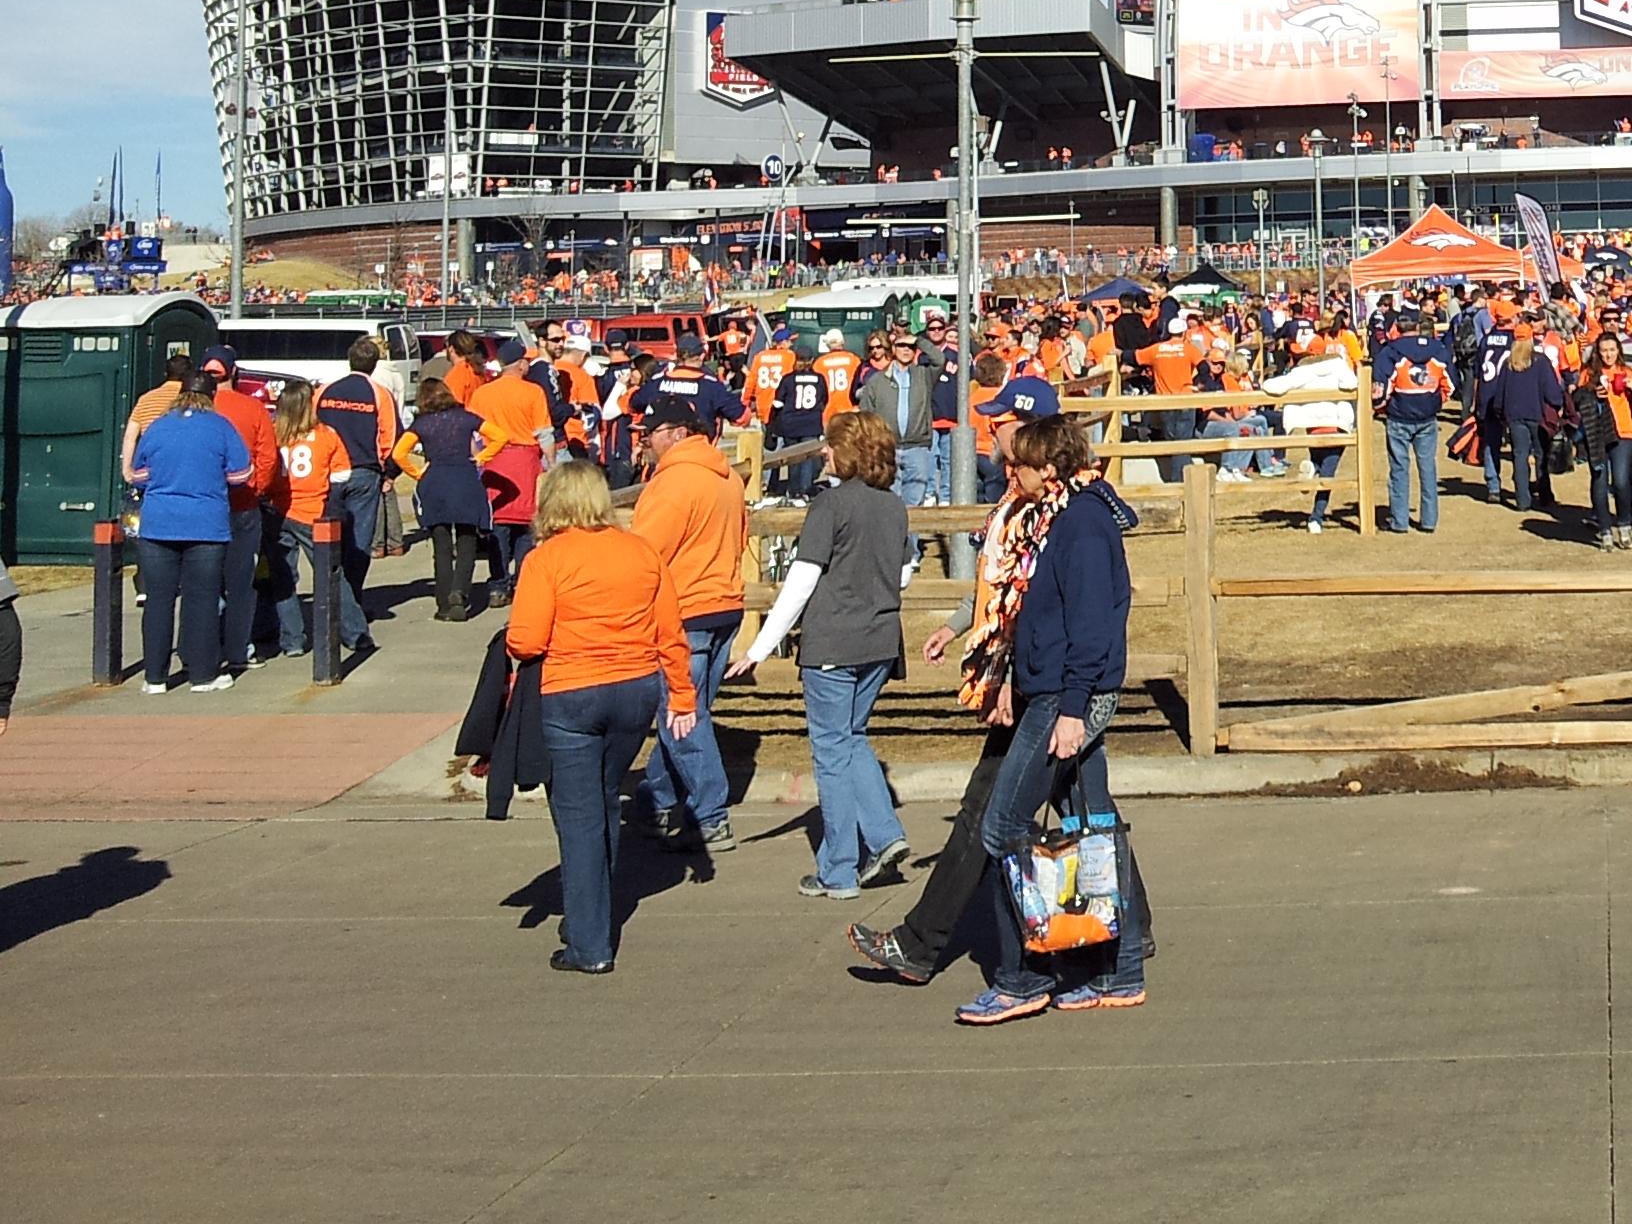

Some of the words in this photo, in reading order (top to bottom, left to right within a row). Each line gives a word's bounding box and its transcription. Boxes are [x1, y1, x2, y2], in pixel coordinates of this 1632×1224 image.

[1243, 7, 1282, 32] IN
[1199, 33, 1398, 71] ORANGE
[766, 160, 782, 175] 10
[758, 366, 782, 389] 83
[828, 369, 848, 392] 18
[320, 398, 375, 414] BRONCOS
[795, 385, 817, 410] 18
